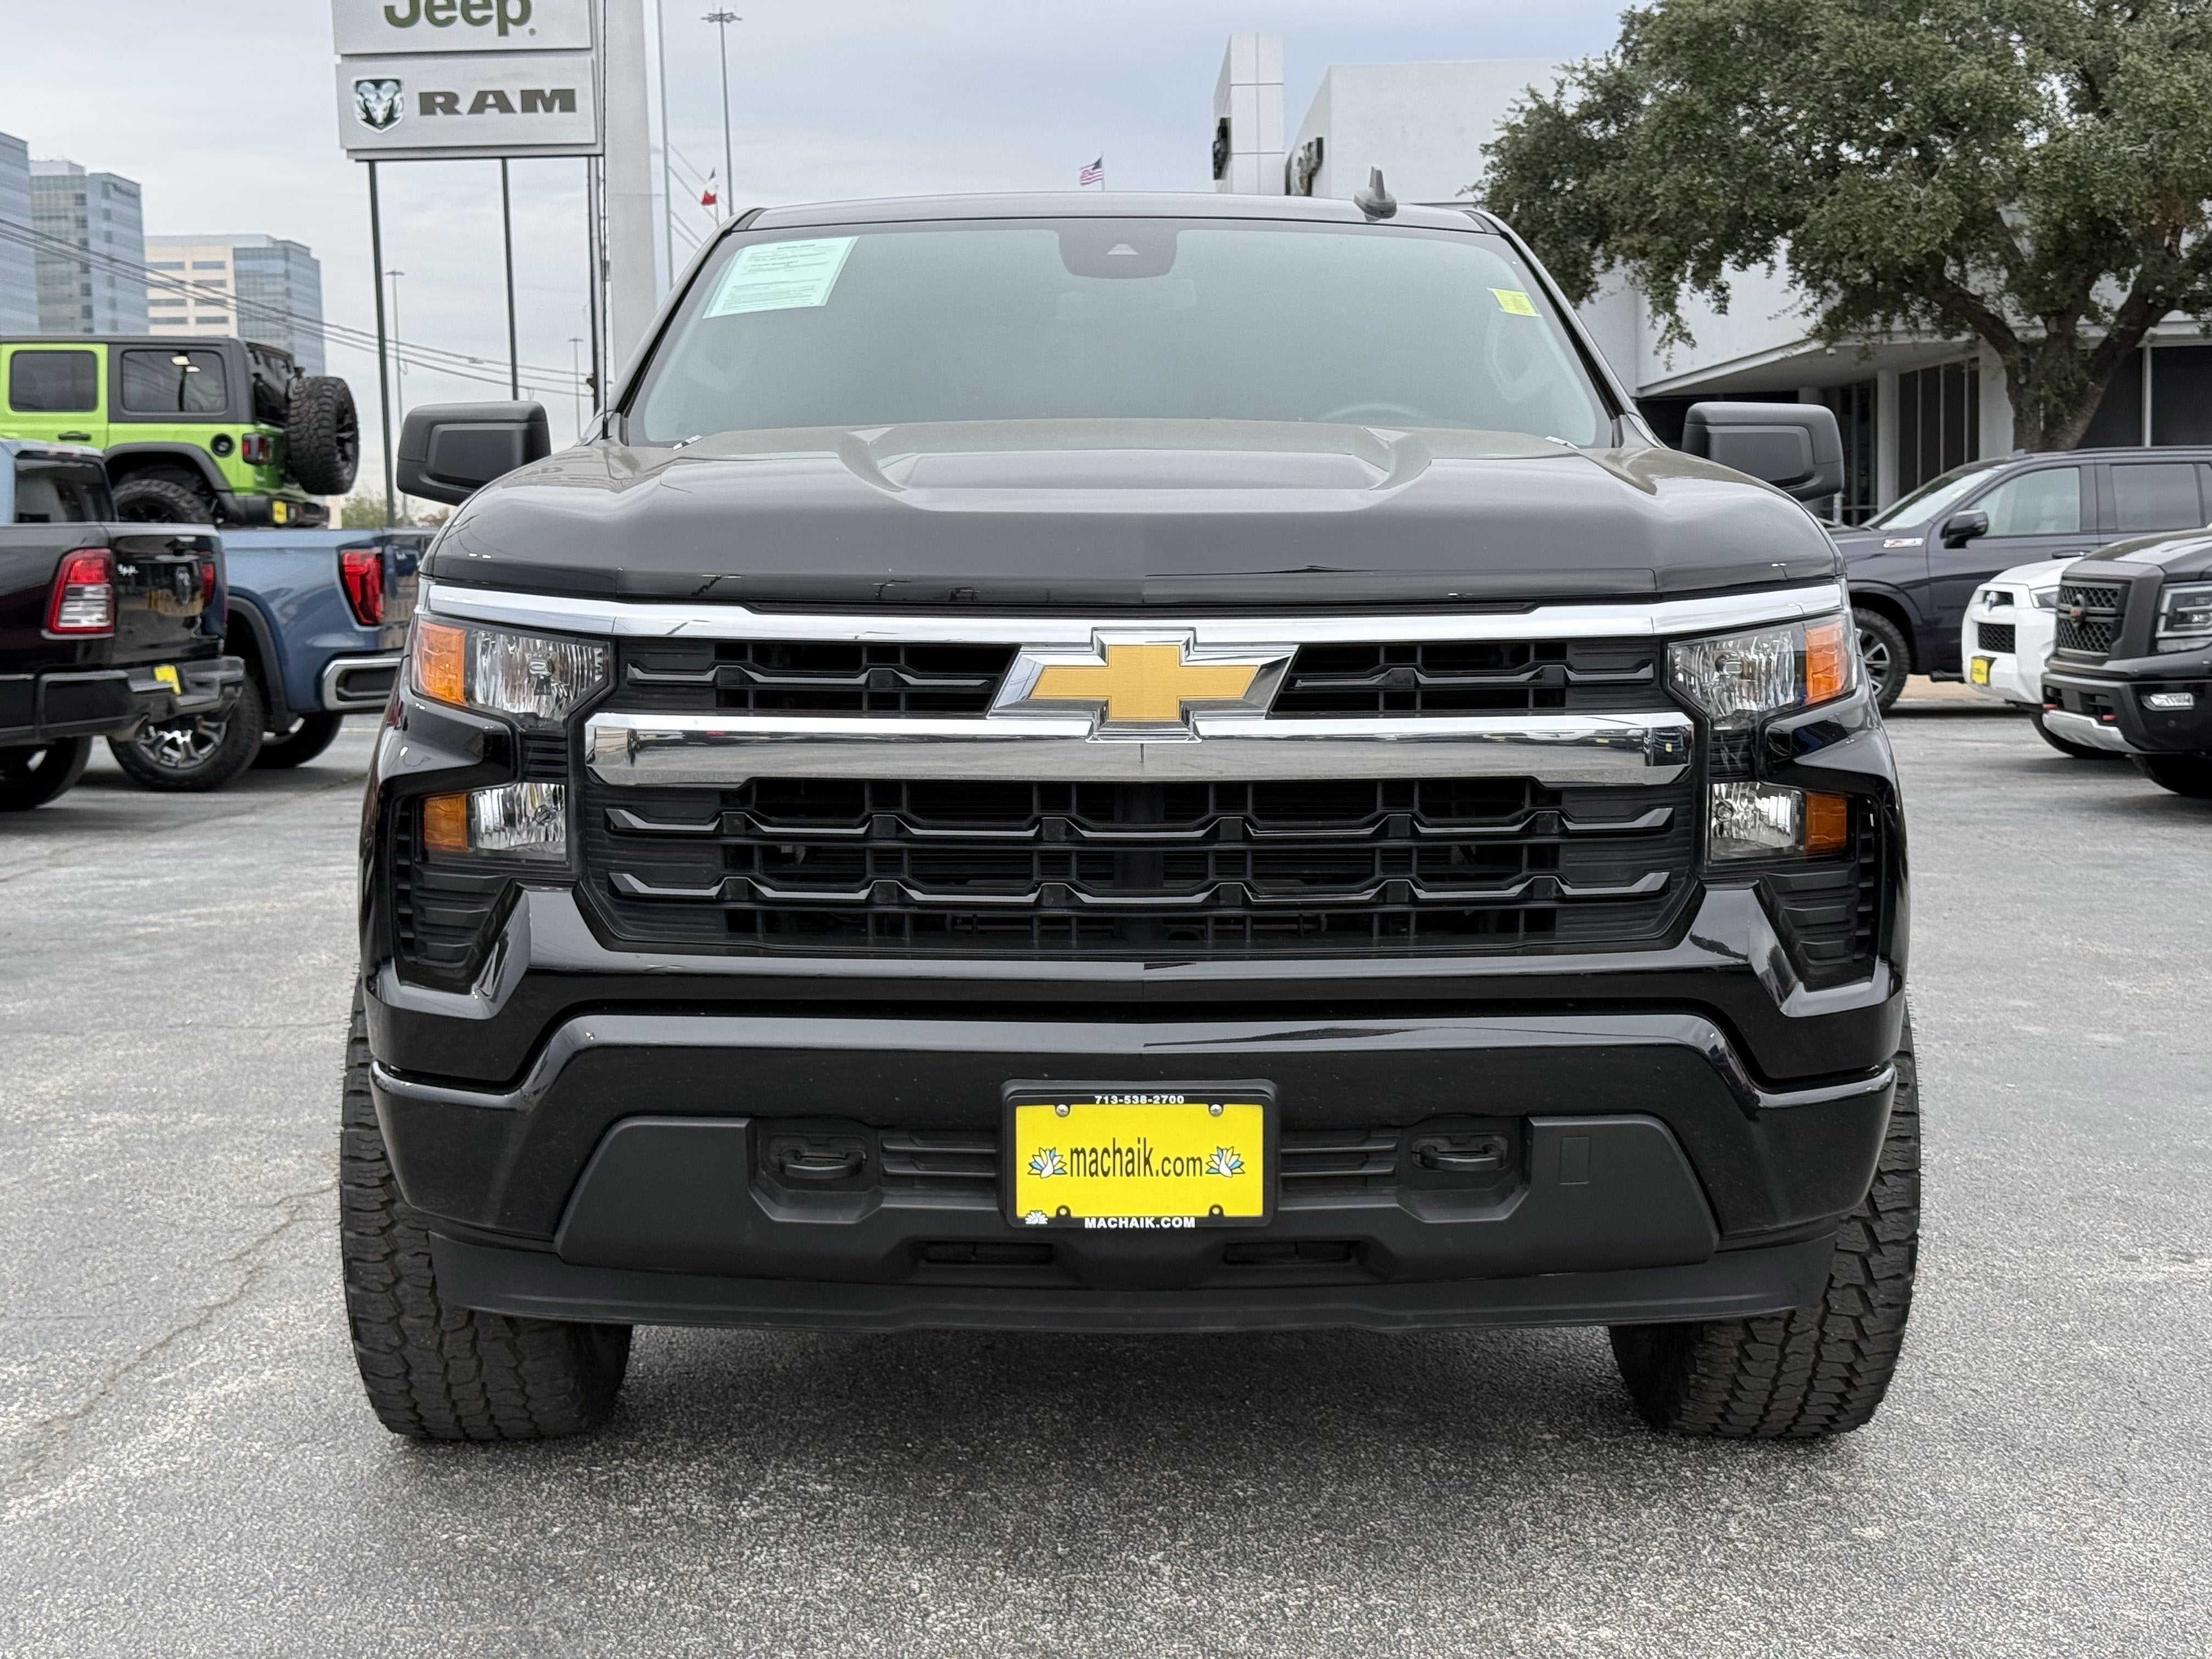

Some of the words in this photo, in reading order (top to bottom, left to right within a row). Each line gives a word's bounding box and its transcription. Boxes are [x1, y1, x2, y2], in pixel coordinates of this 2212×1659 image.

[419, 88, 576, 116] RAM
[1094, 1095, 1185, 1104] 713-538-2700
[1069, 1137, 1203, 1177] machaik.com
[1084, 1217, 1195, 1228] MACHAIK.COM
